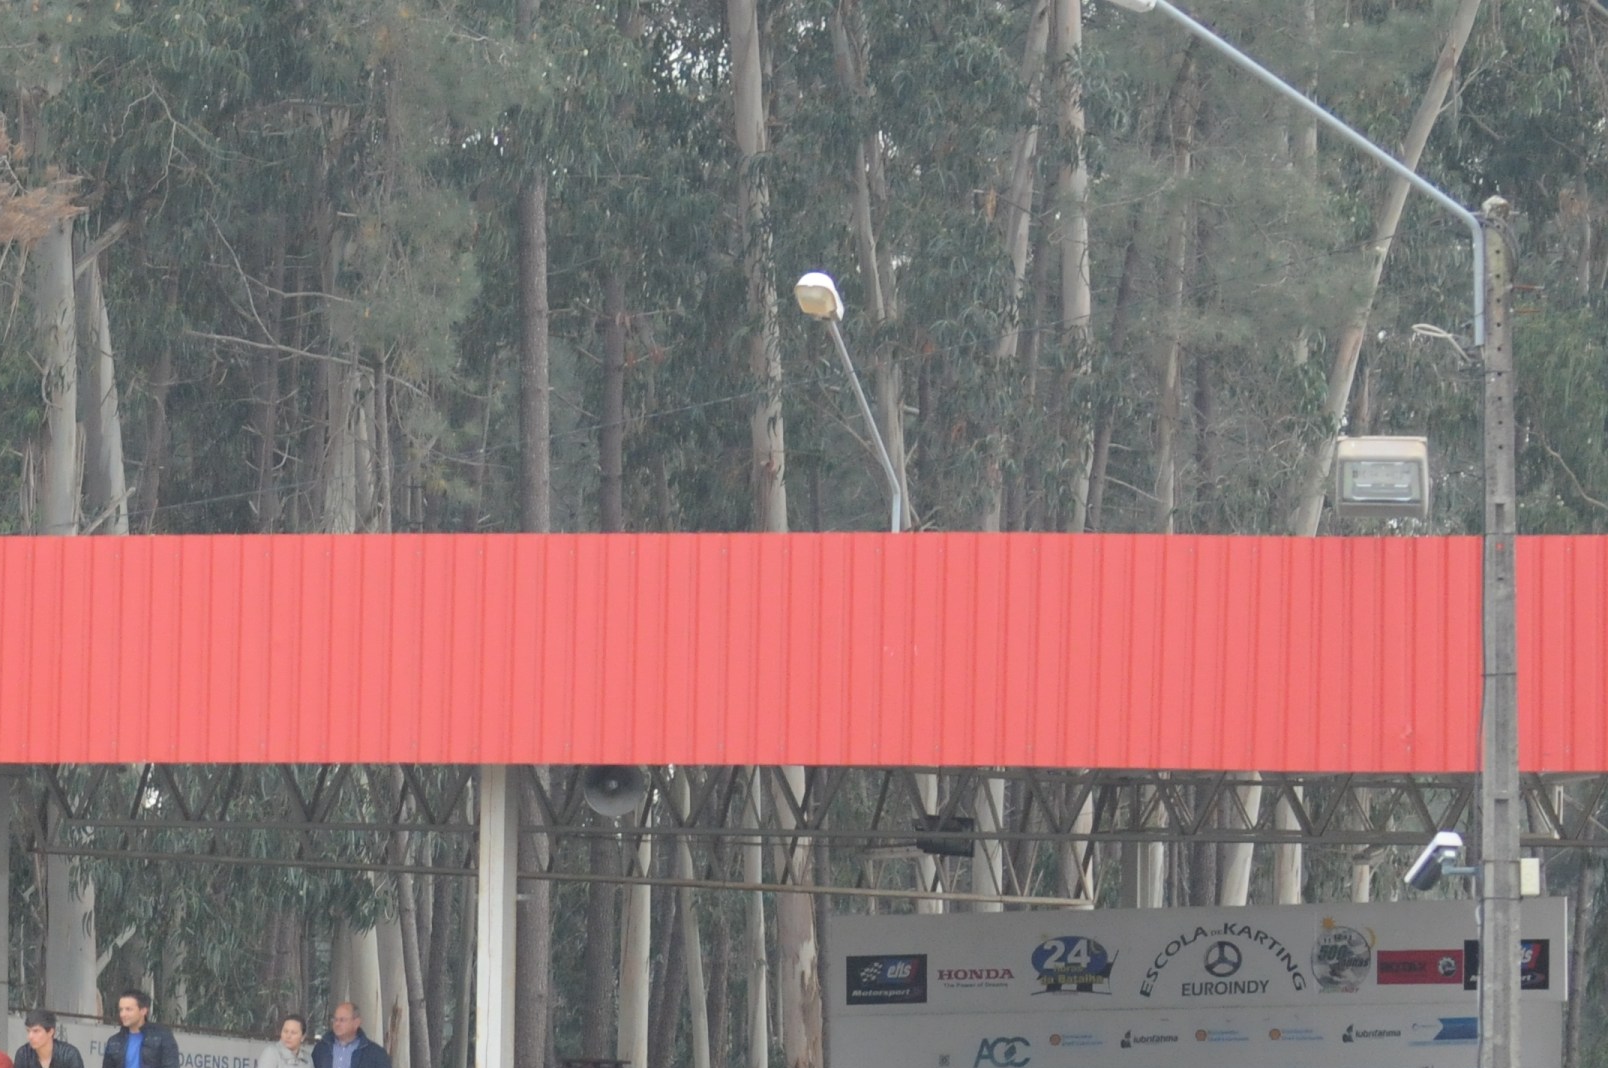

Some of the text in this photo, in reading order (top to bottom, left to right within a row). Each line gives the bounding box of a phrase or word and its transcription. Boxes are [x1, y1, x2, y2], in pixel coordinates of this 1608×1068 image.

[1043, 939, 1091, 969] 24
[1140, 926, 1208, 998] ESCOLA
[1223, 922, 1307, 992] KARTING
[937, 968, 1015, 981] HONDA
[1181, 979, 1270, 997] EUROINDY
